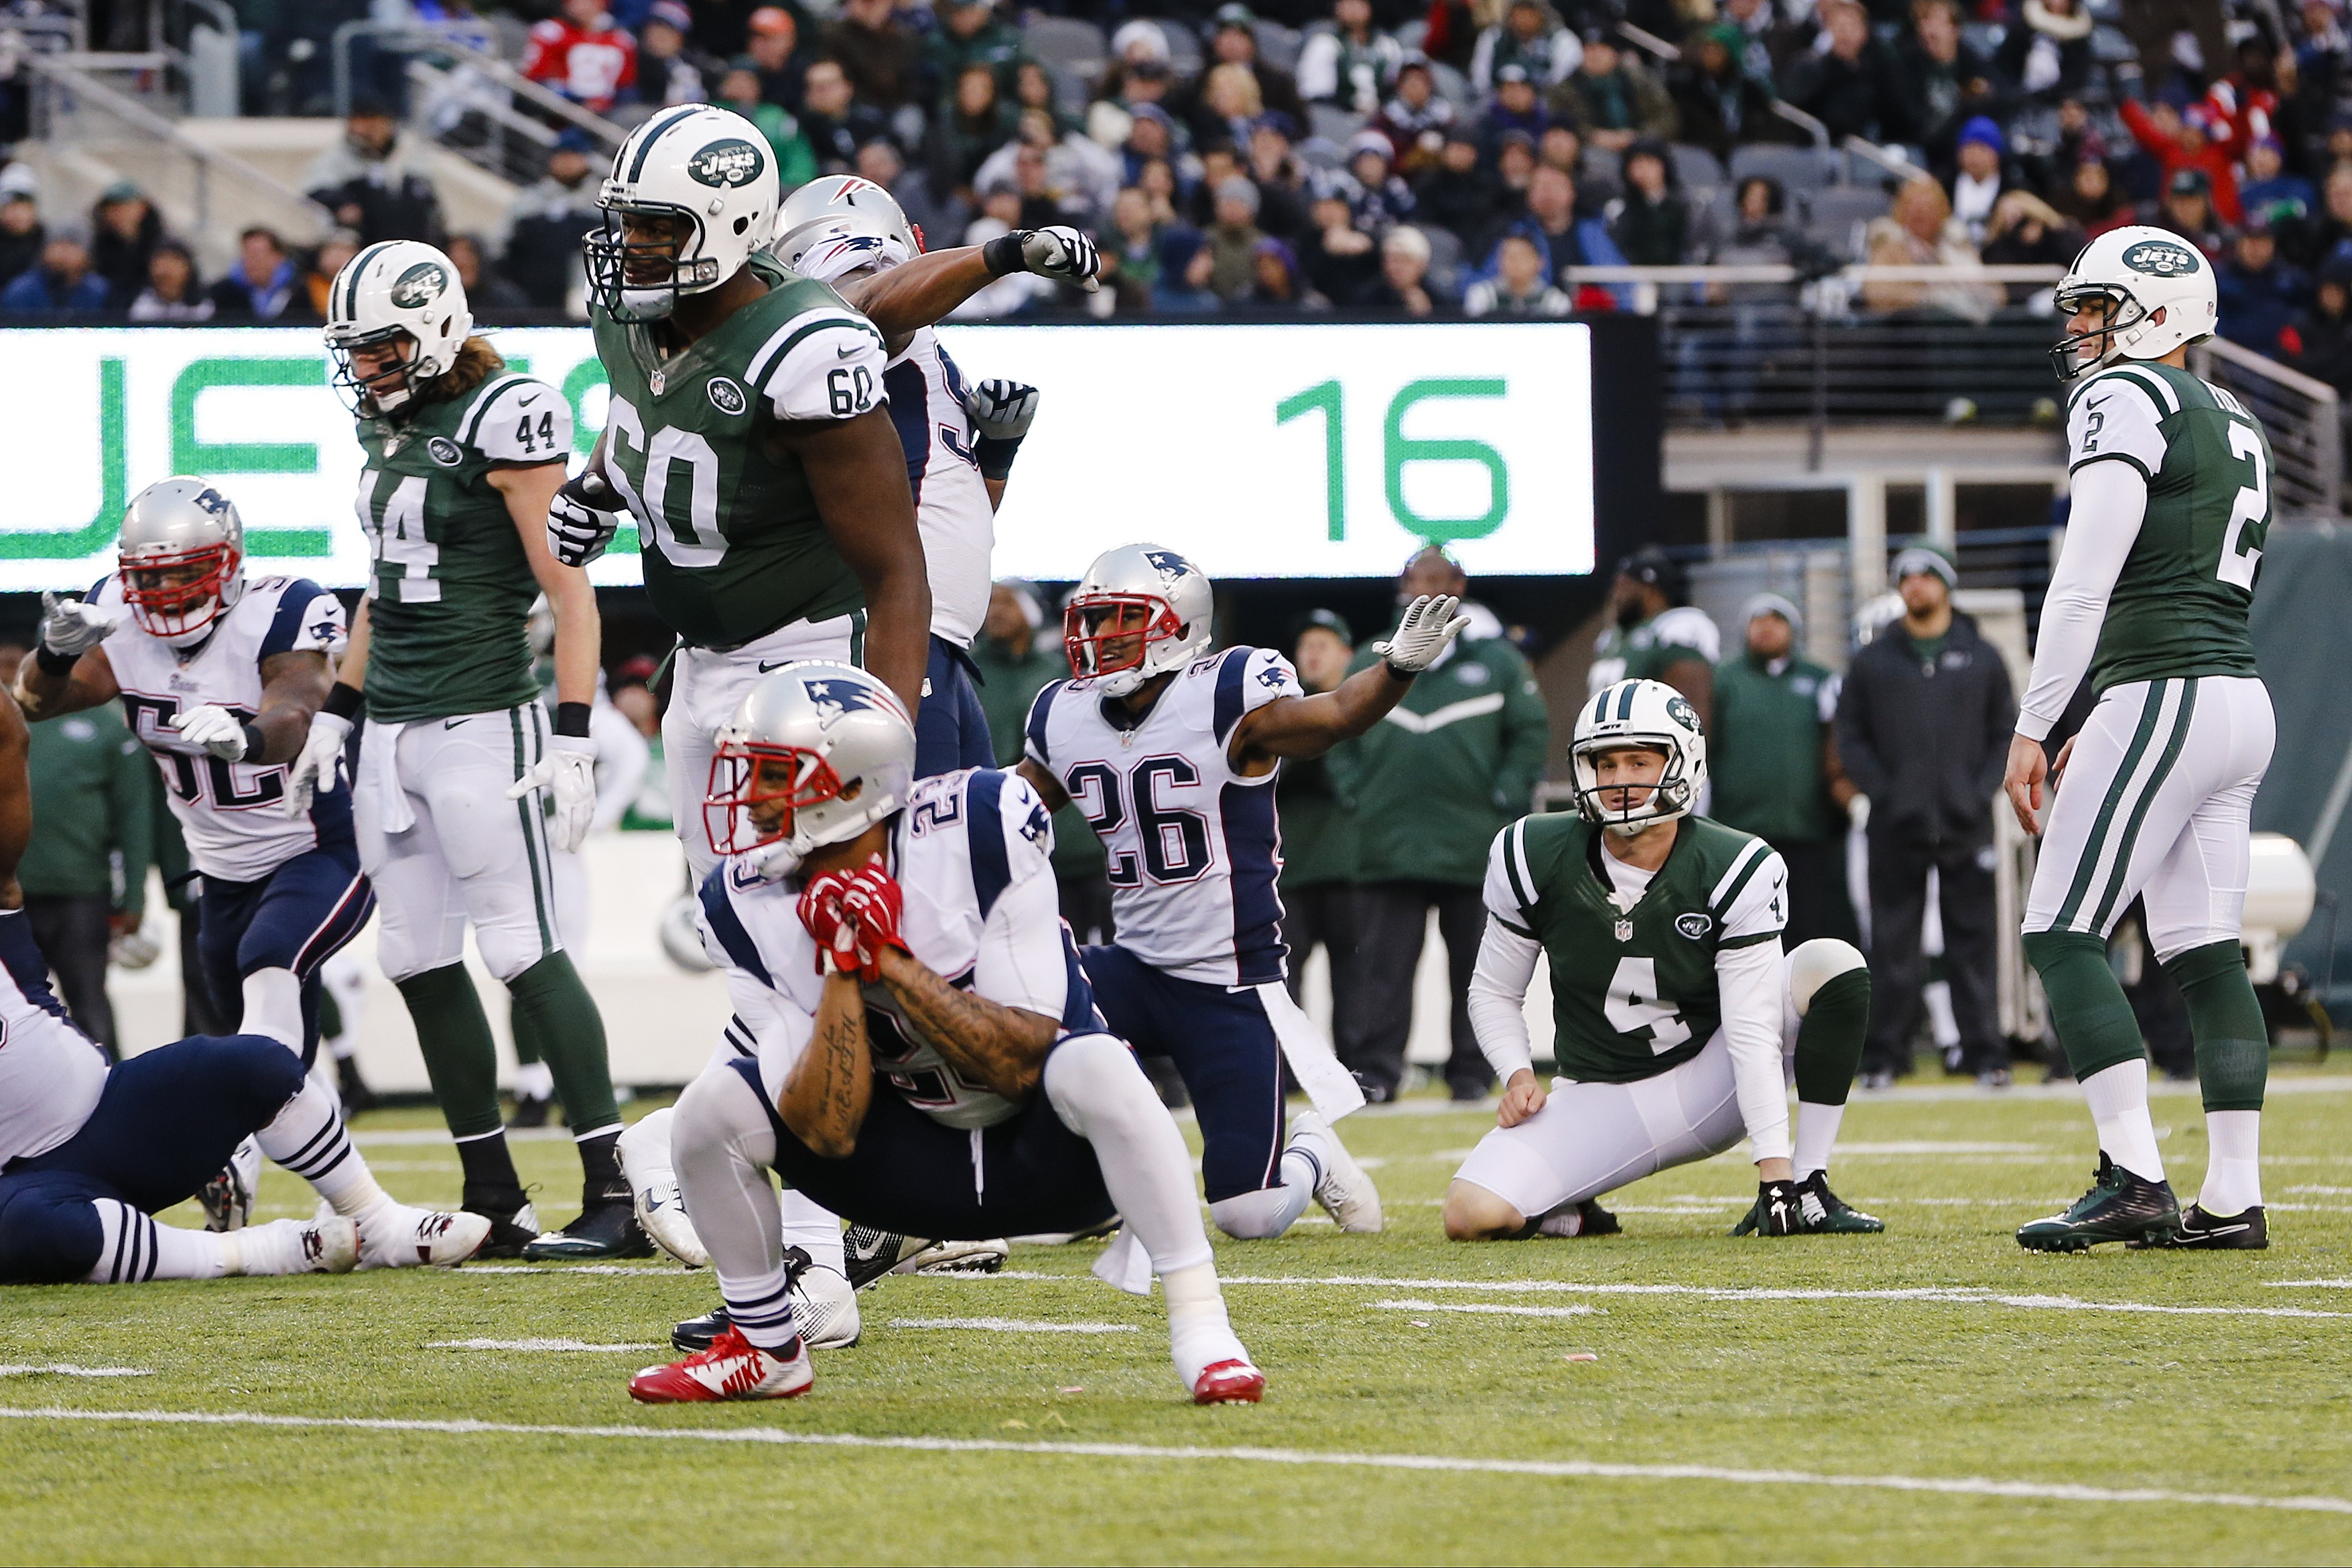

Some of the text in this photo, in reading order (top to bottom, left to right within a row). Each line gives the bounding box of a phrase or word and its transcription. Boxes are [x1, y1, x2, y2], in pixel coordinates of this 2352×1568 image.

[701, 152, 755, 176] JETS
[2133, 249, 2189, 265] JETS
[827, 366, 873, 415] 60
[517, 411, 555, 453] 44
[2081, 412, 2104, 453] 2
[604, 393, 730, 568] 60
[1275, 379, 1508, 541] 16
[2215, 418, 2269, 592] 2
[1065, 753, 1214, 888] 26
[1769, 896, 1784, 922] 4
[1604, 956, 1693, 1056] 4
[722, 1350, 767, 1399] NIKE
